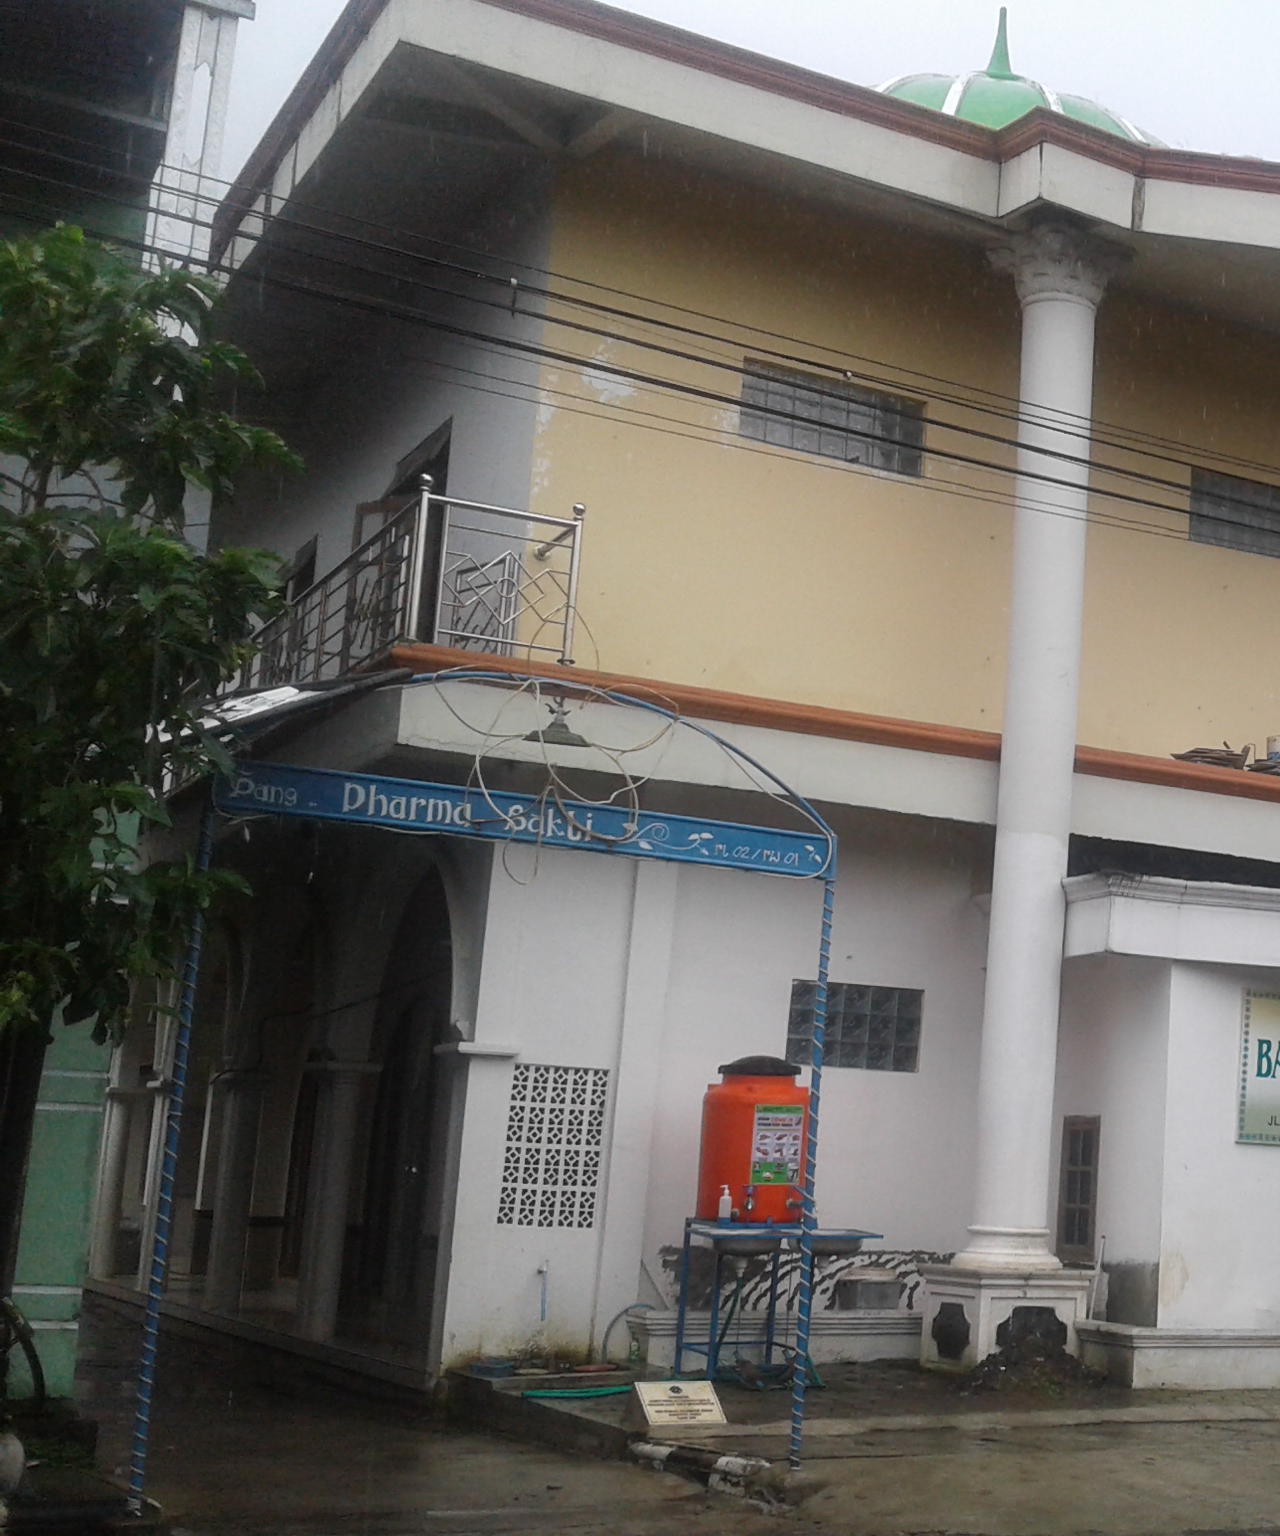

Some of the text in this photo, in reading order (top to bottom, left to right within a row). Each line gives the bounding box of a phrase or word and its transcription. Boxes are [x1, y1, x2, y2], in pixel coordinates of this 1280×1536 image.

[342, 782, 472, 828] Dharma
[503, 804, 593, 842] Bakti
[783, 852, 799, 867] 01
